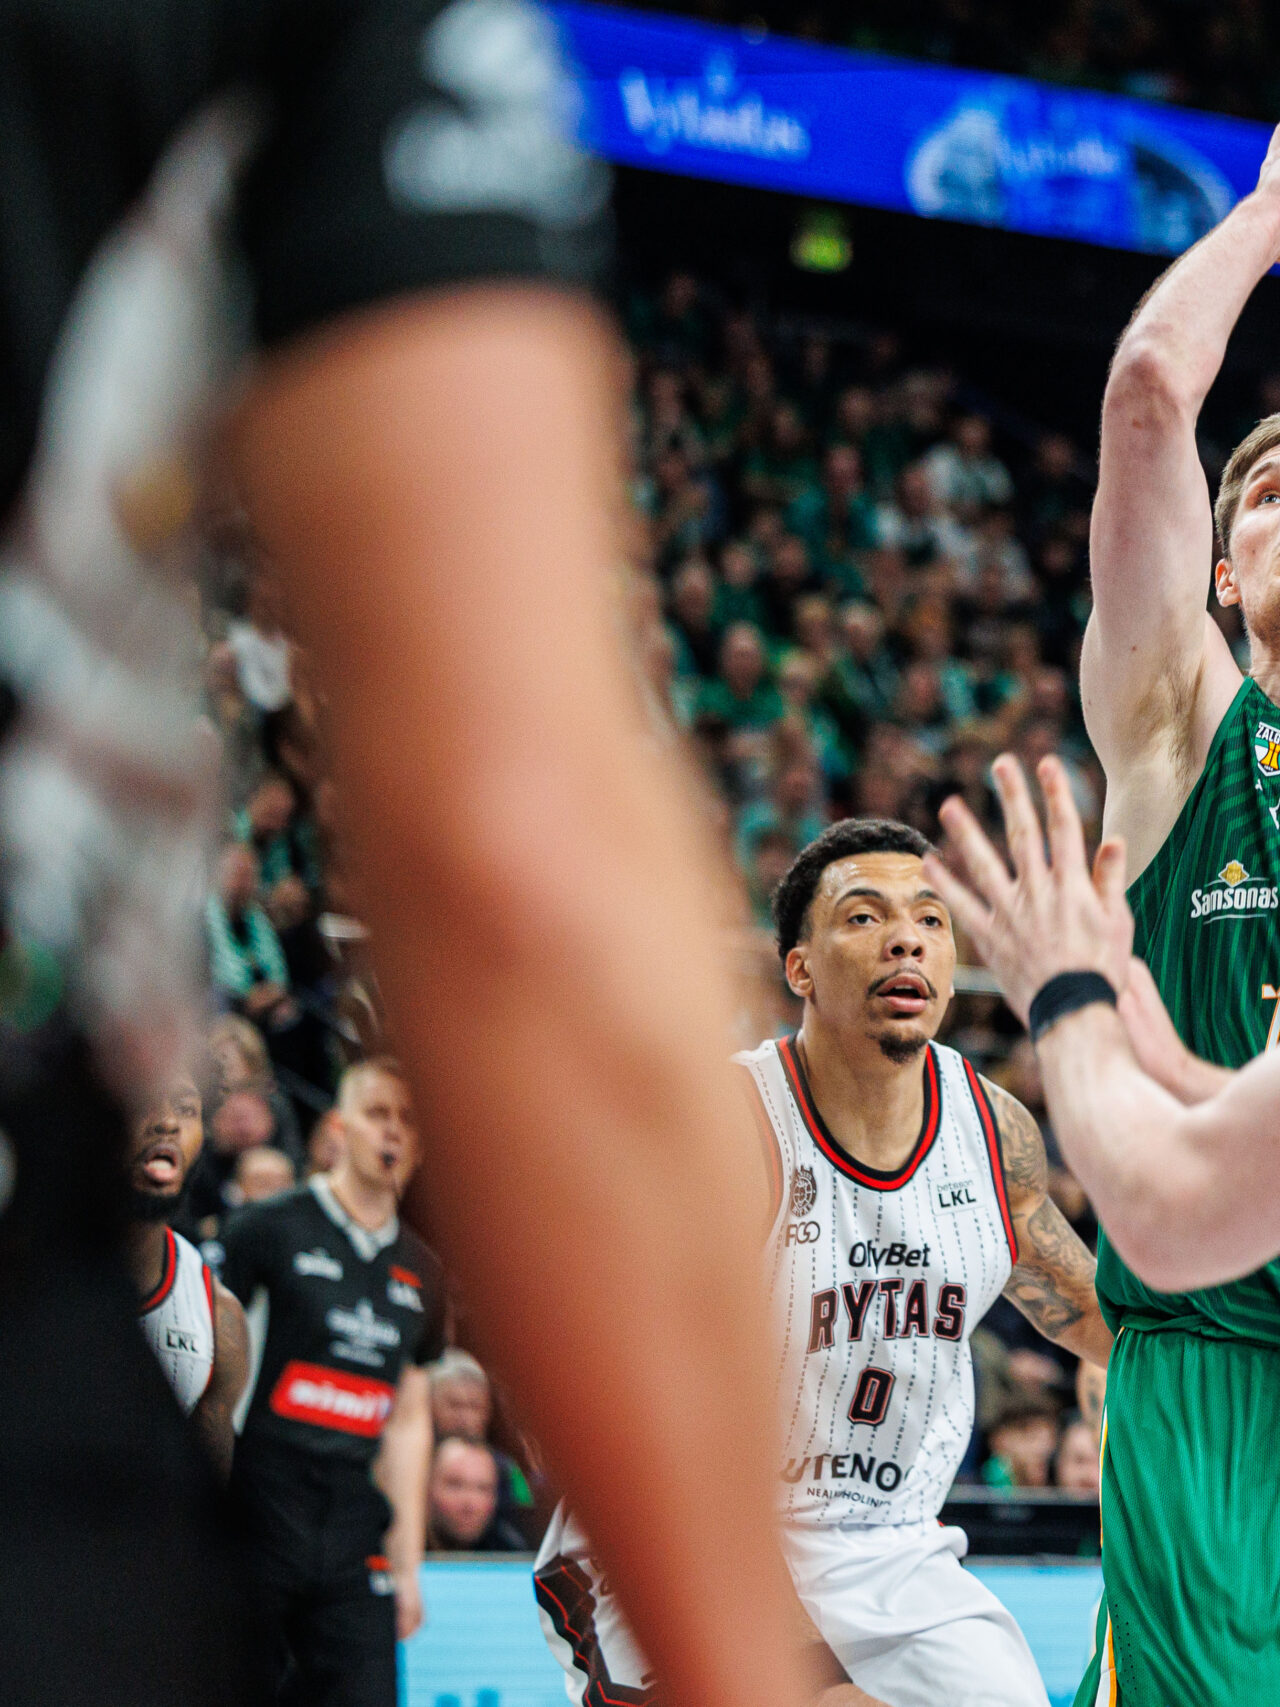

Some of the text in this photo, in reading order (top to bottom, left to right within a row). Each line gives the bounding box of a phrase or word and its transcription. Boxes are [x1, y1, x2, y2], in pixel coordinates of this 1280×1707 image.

[1190, 886, 1279, 918] Samsonas
[938, 1188, 977, 1208] LKL
[849, 1240, 931, 1274] OlyBet
[807, 1277, 967, 1355] RYTAS
[847, 1366, 897, 1427] 0
[780, 1453, 914, 1492] UTENO
